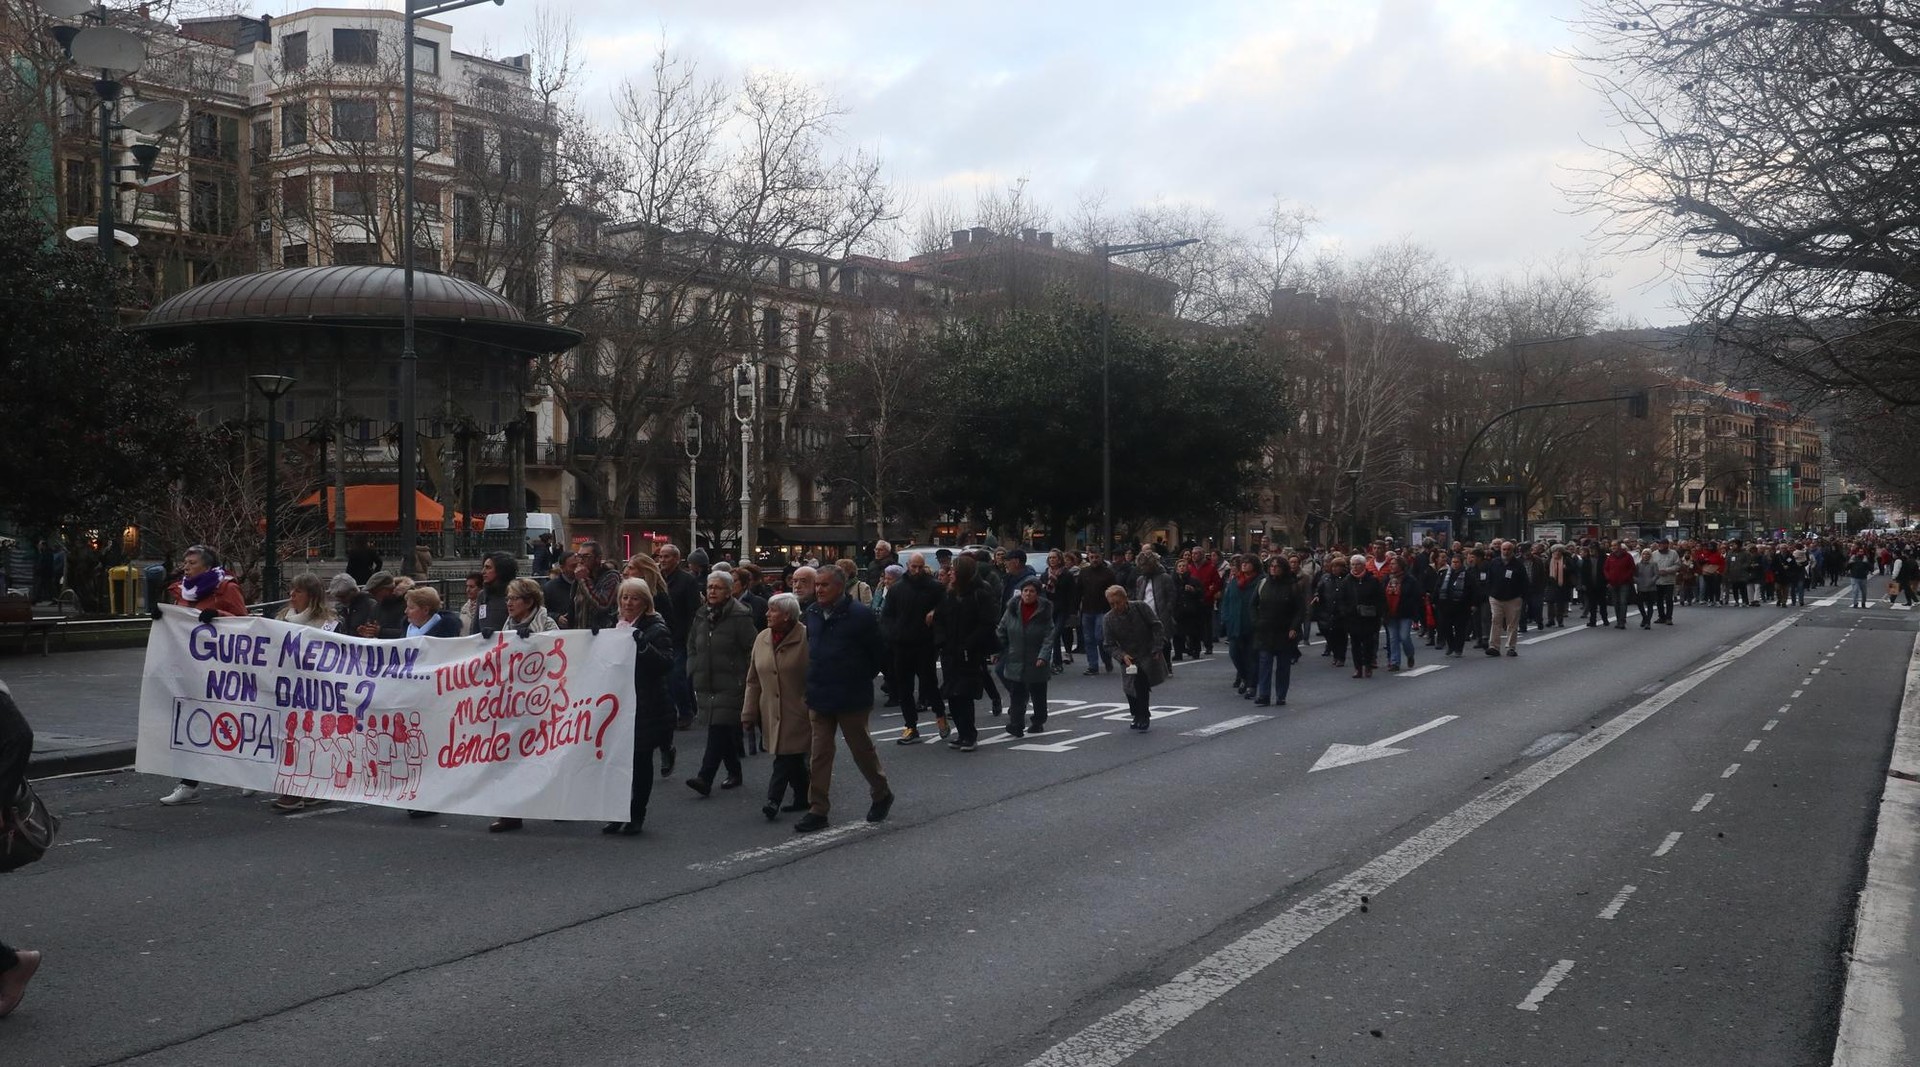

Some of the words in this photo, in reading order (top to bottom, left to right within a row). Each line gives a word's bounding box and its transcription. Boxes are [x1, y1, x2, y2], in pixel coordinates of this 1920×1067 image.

[189, 623, 271, 666] GURE
[206, 670, 257, 702] NON
[438, 715, 511, 768] dónde
